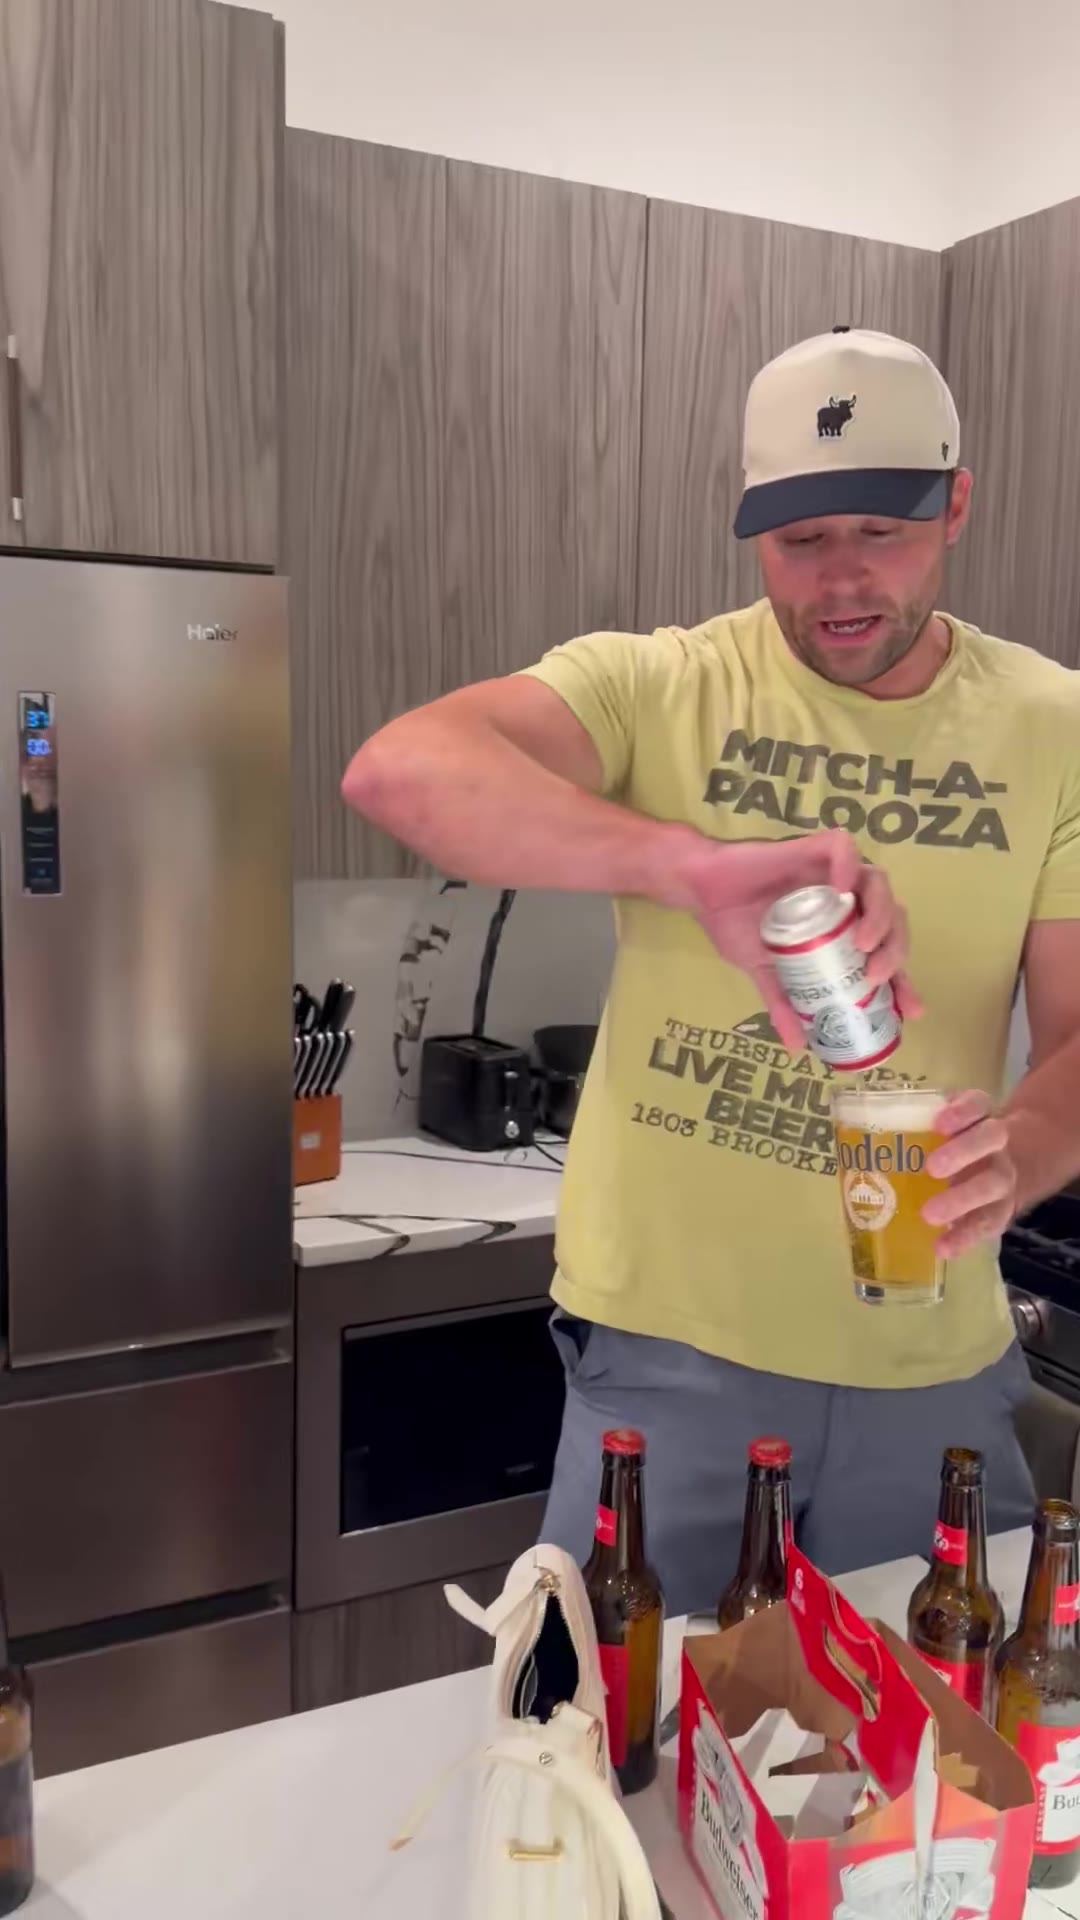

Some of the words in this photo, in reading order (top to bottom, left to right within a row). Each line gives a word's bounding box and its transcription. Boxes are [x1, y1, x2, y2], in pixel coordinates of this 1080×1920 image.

[186, 623, 239, 641] Haier
[720, 728, 1008, 800] MITCH-A-
[702, 767, 1011, 852] PALOOZA
[648, 1036, 758, 1094] LIVE
[665, 1017, 837, 1080] THURSDAY
[838, 1133, 925, 1173] odelo
